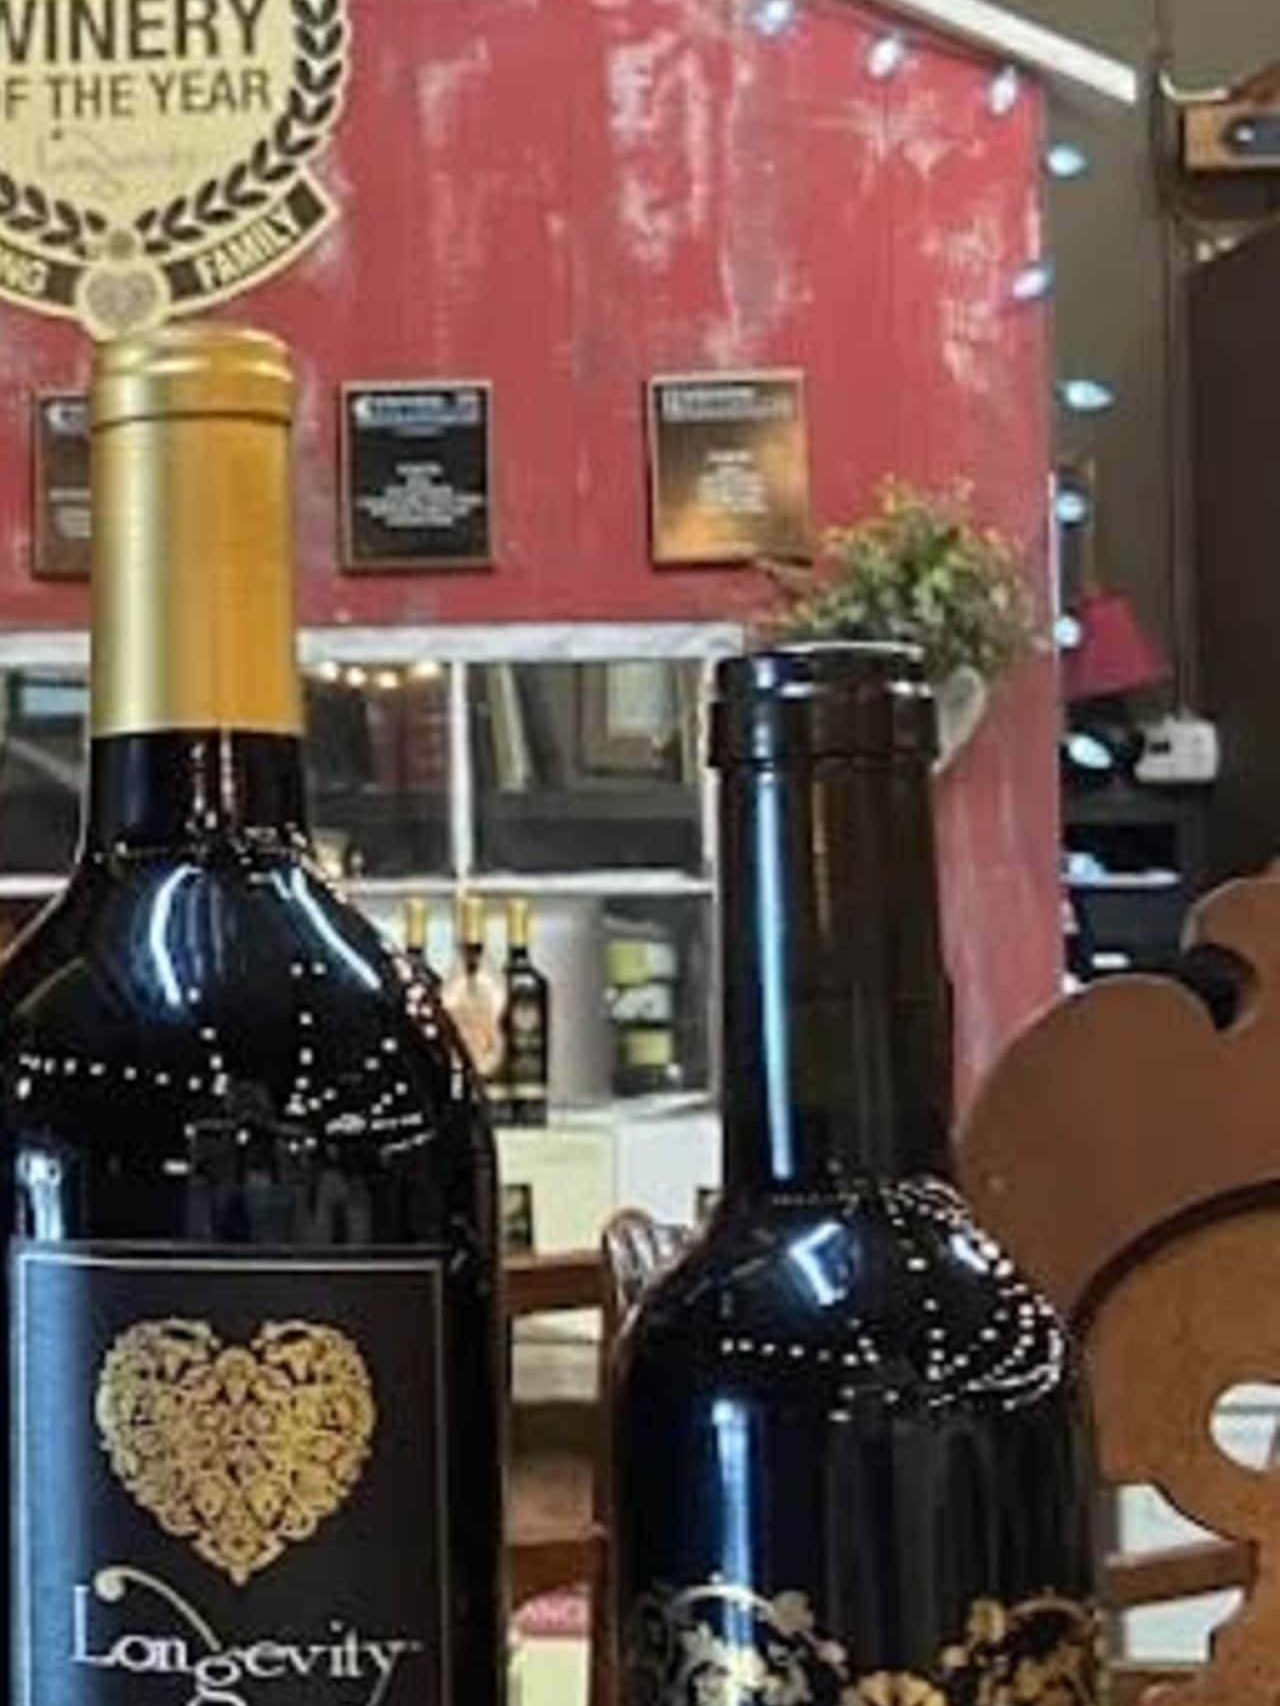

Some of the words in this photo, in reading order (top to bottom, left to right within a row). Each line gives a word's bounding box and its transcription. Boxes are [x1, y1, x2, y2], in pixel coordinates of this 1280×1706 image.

[39, 73, 138, 121] THE
[147, 68, 272, 116] YEAR
[193, 201, 303, 291] FAMILY
